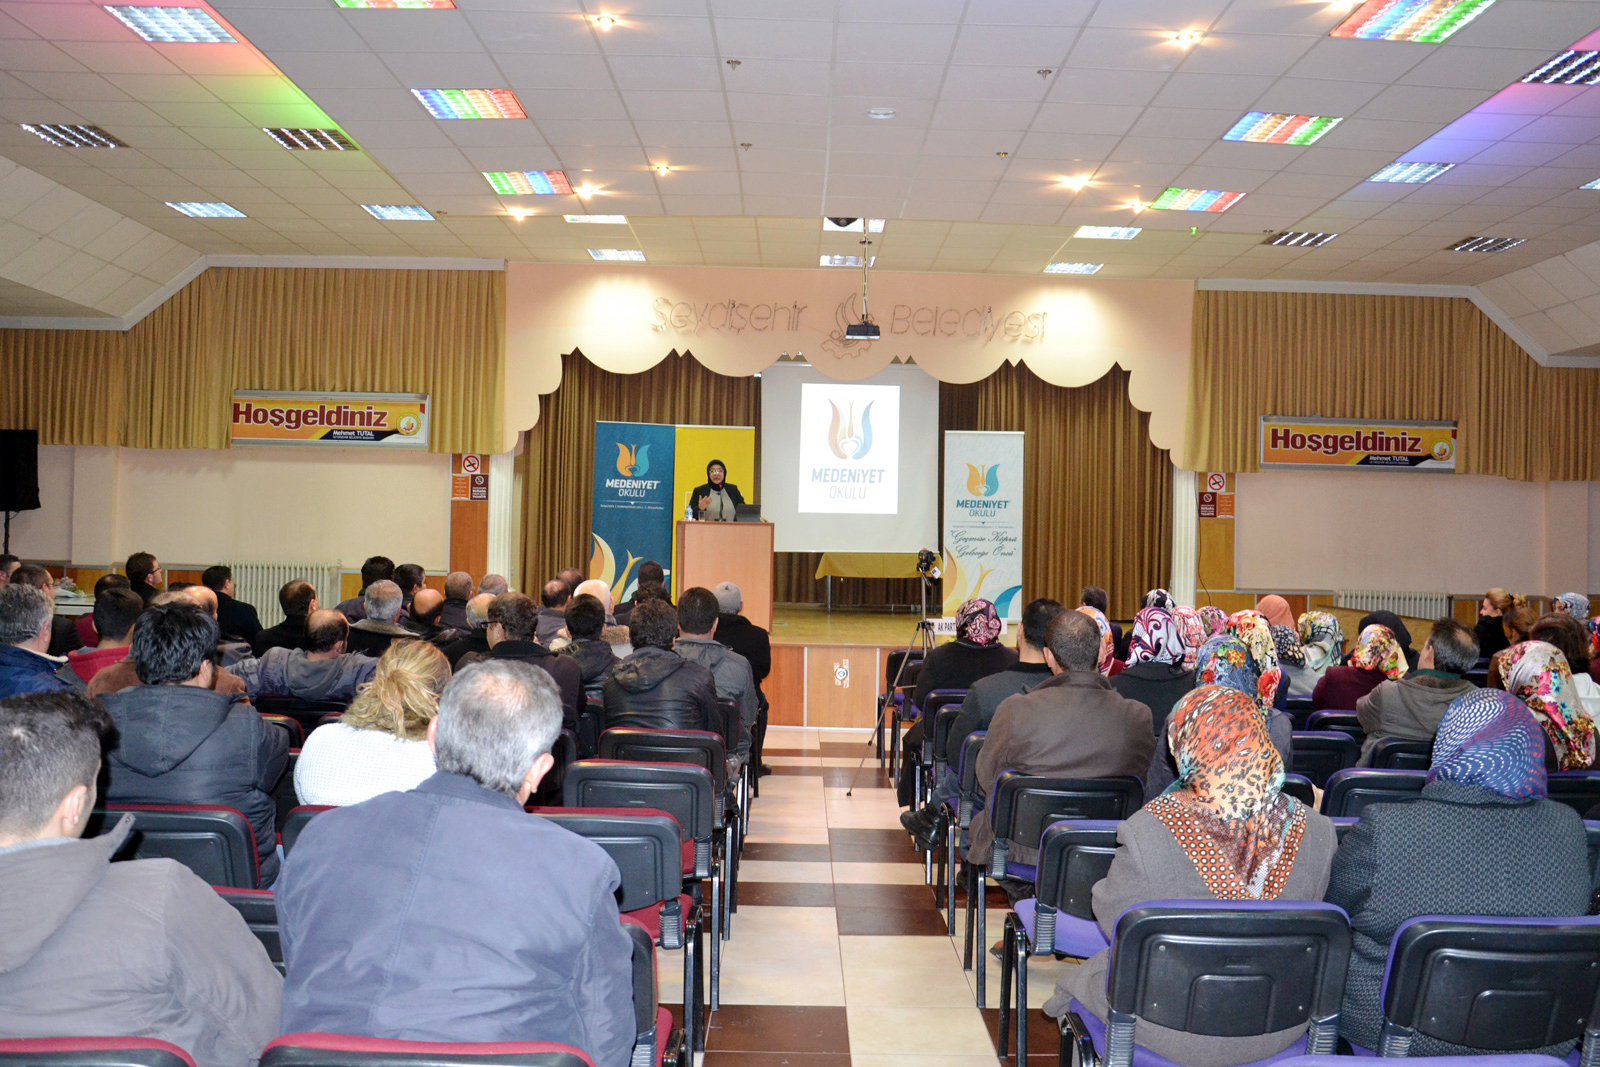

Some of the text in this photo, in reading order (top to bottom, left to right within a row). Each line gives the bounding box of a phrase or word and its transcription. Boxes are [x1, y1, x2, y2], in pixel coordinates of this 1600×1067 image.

[232, 402, 388, 430] Hoşgeldiniz
[1270, 427, 1422, 455] Hoşgeldiniz
[618, 489, 646, 497] OKULU
[829, 486, 866, 499] OKULU
[969, 509, 996, 517] OKULU
[938, 622, 944, 631] AK
